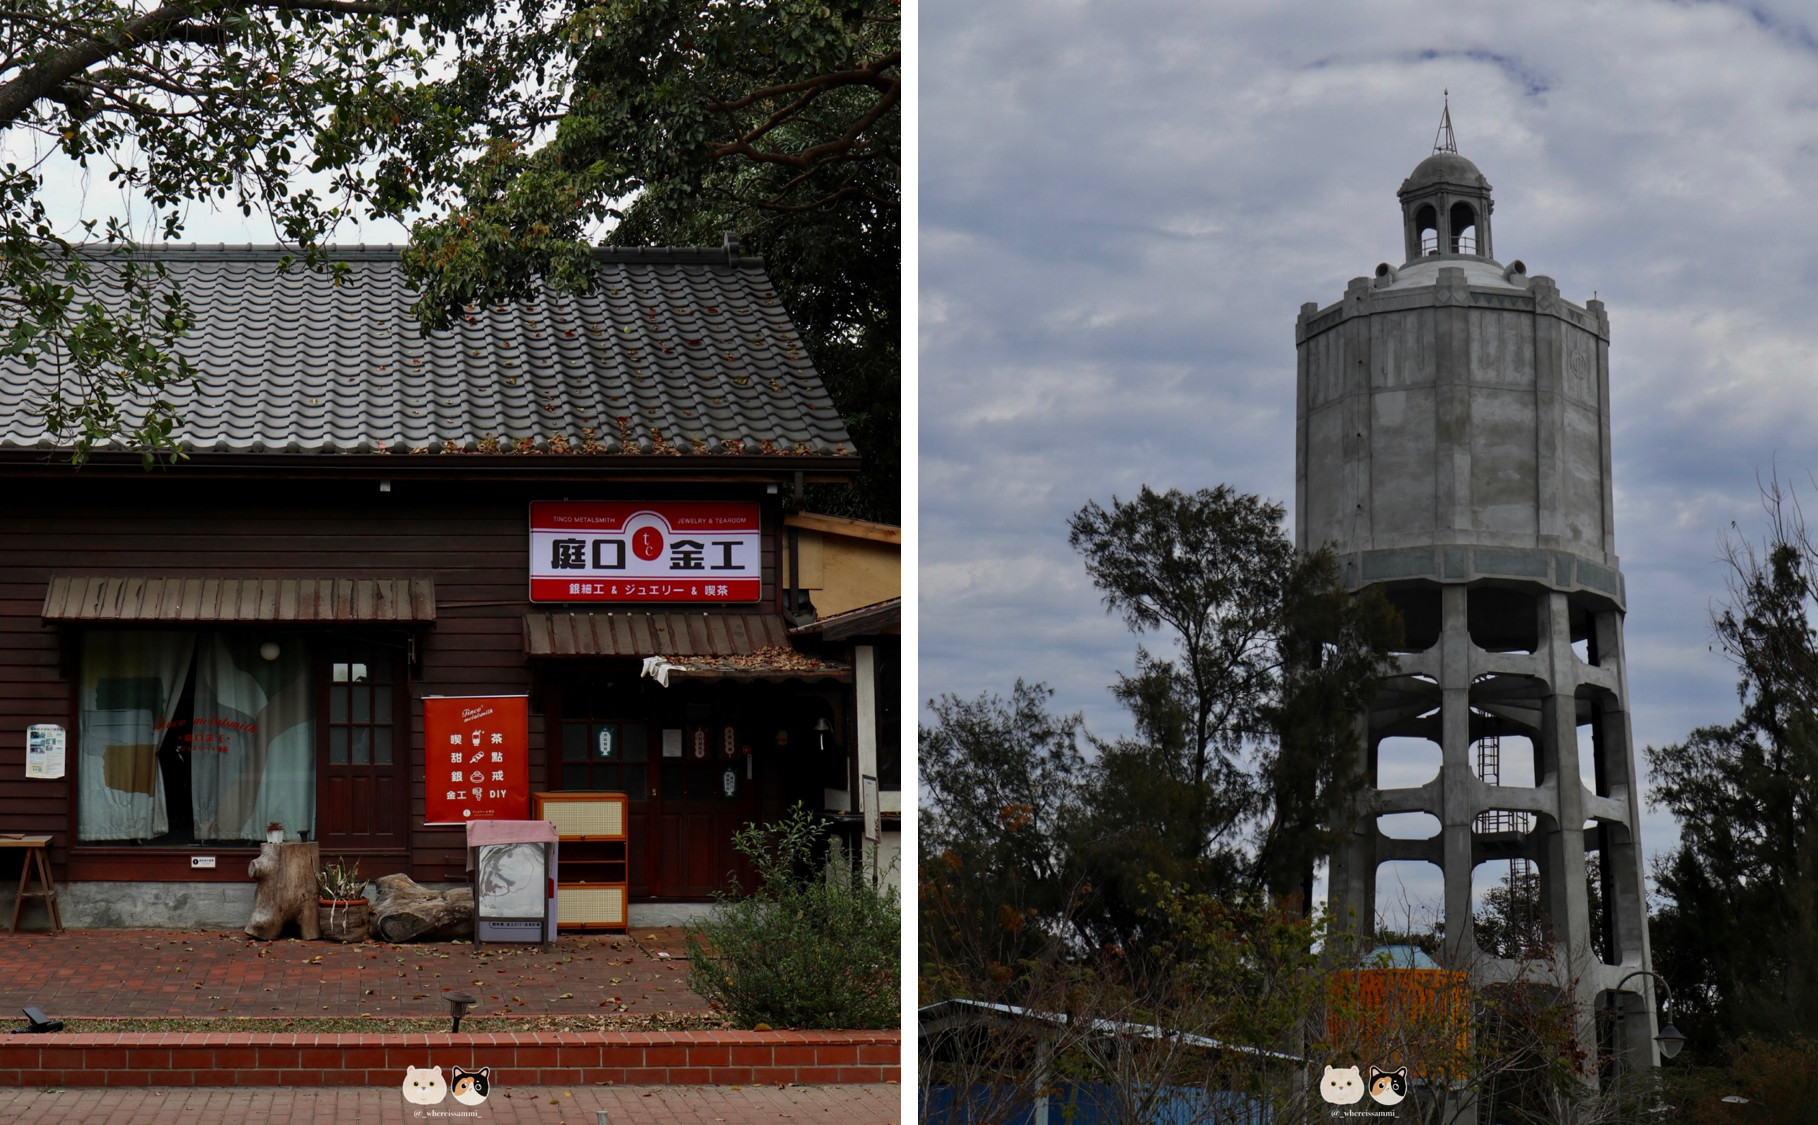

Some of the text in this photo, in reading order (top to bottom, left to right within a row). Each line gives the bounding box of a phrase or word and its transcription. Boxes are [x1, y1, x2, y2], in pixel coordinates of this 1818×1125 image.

[551, 538, 746, 570] 庭口 金工
[569, 583, 729, 596] 銀細工 & ジュエリー & 喫茶
[461, 706, 482, 718] Tinco
[192, 716, 257, 734] metalsmith
[446, 789, 507, 800] 金工 DIY
